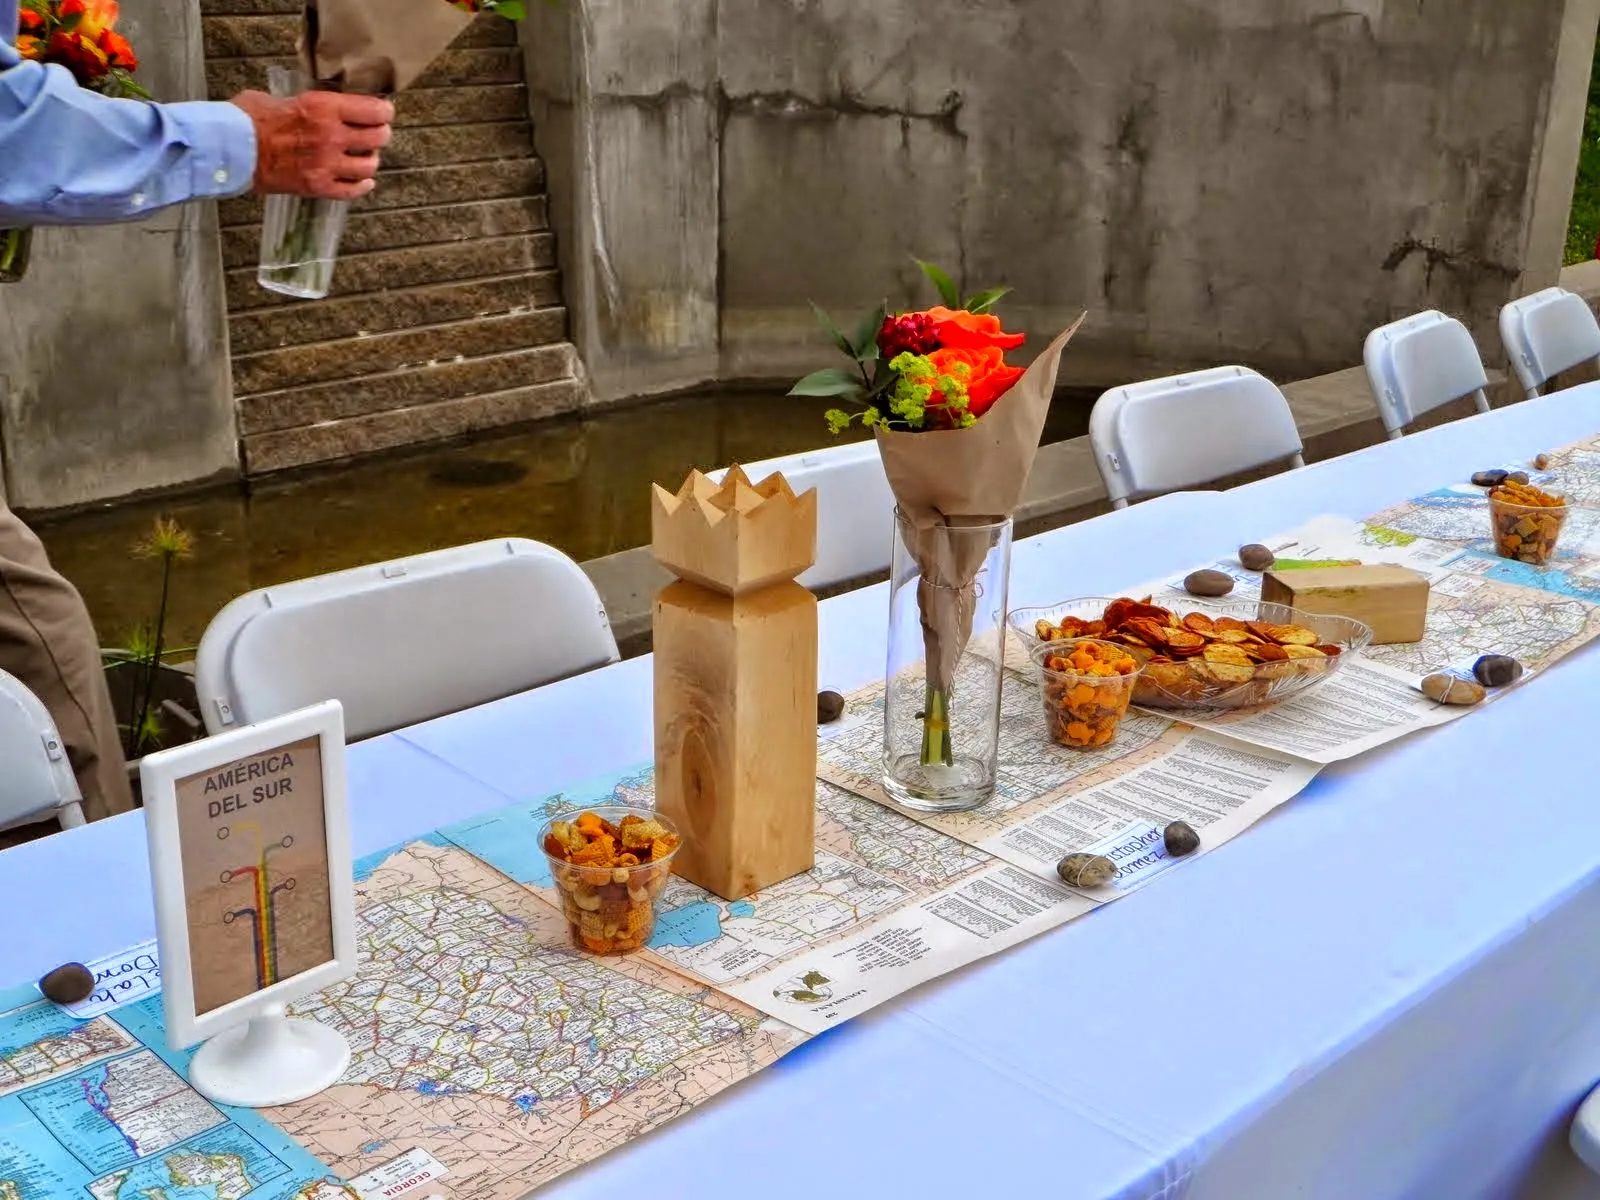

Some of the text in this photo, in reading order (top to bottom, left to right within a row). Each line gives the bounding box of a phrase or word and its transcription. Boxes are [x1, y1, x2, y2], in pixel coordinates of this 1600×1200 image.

[204, 752, 294, 795] AMÉRICA
[208, 777, 293, 819] DEL SUR
[1107, 828, 1162, 860] istopher
[384, 1173, 431, 1196] GEORGIA
